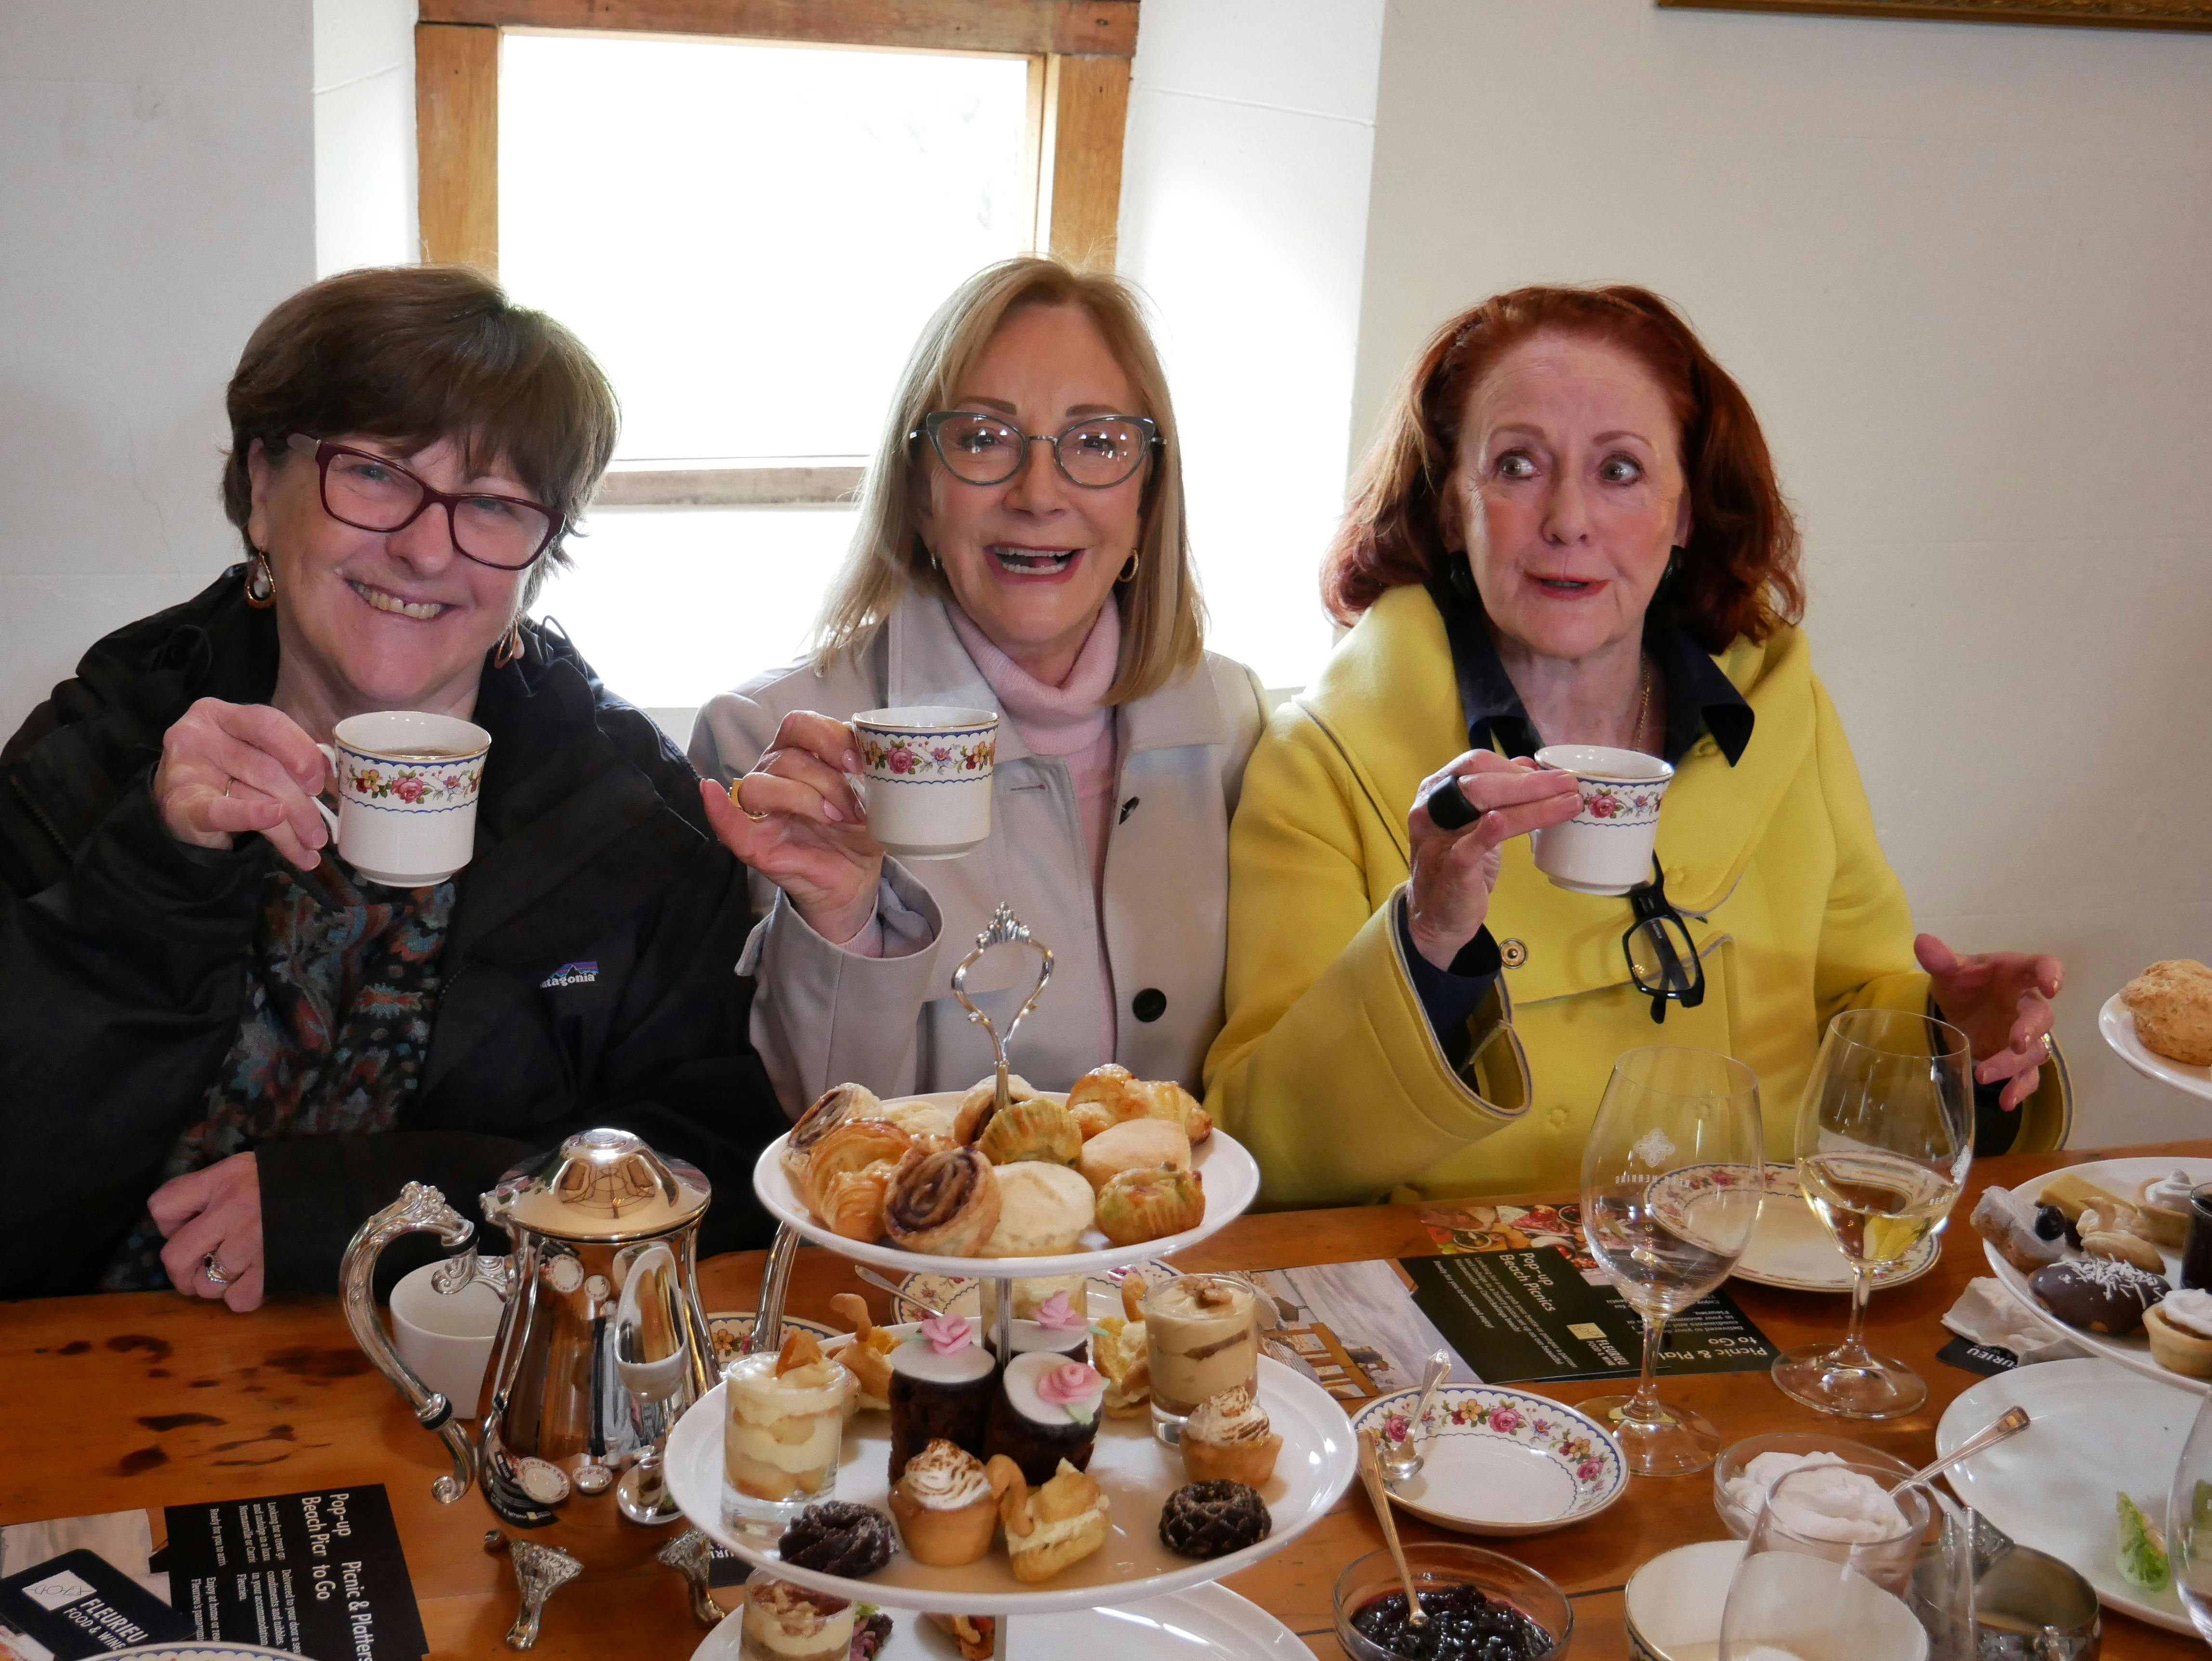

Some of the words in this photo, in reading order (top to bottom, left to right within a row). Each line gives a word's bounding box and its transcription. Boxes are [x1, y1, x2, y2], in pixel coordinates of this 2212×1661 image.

[1519, 1252, 1554, 1286] Pop-up
[1433, 1260, 1448, 1274] Ready
[1447, 1280, 1460, 1289] you
[1460, 1294, 1475, 1306] arrive
[1471, 1306, 1484, 1316] and
[1499, 1254, 1531, 1281] Beach
[1523, 1282, 1556, 1311] Picnics
[1480, 1290, 1507, 1318] Carrickalinga
[1492, 1292, 1508, 1305] luxury
[1502, 1305, 1520, 1319] picnic
[1541, 1345, 1564, 1364] beautiful
[1514, 1305, 1528, 1315] your
[1539, 1332, 1560, 1349] pamper
[1557, 1352, 1579, 1368] partner
[1595, 1339, 1630, 1365] FLEURIEU
[1708, 1337, 1736, 1346] Go
[1714, 1346, 1768, 1357] Picnic
[1586, 1340, 1602, 1352] FOOD
[1601, 1356, 1617, 1366] WINE
[1696, 1350, 1712, 1358] &
[210, 1508, 222, 1525] Ready
[253, 1503, 264, 1515] and
[267, 1502, 279, 1525] Looking
[301, 1496, 328, 1532] Beach
[327, 1493, 352, 1537] Pop-up
[212, 1526, 223, 1534] for
[238, 1505, 253, 1539] Normanville
[255, 1514, 267, 1536] indulge
[272, 1525, 282, 1533] for
[211, 1534, 223, 1546] you
[275, 1538, 285, 1552] treat
[251, 1572, 262, 1580] in
[312, 1564, 330, 1578] to
[341, 1561, 365, 1599] Picnic
[191, 1579, 204, 1609] Fleurieu's
[205, 1577, 217, 1595] Enjoy
[236, 1574, 249, 1602] Fleurieu.
[250, 1580, 262, 1595] your
[266, 1571, 279, 1608] condiments
[281, 1569, 296, 1599] Delivered
[315, 1580, 336, 1600] Go
[209, 1602, 220, 1621] home
[272, 1608, 284, 1621] and
[285, 1606, 297, 1621] your
[348, 1600, 370, 1612] &
[63, 1607, 94, 1628] FOOD
[88, 1625, 102, 1634] &
[97, 1631, 126, 1650] WINE
[79, 1597, 149, 1644] FLEURIEU
[289, 1621, 300, 1636] door
[350, 1613, 375, 1661] Platters
[292, 1642, 302, 1655] sea
